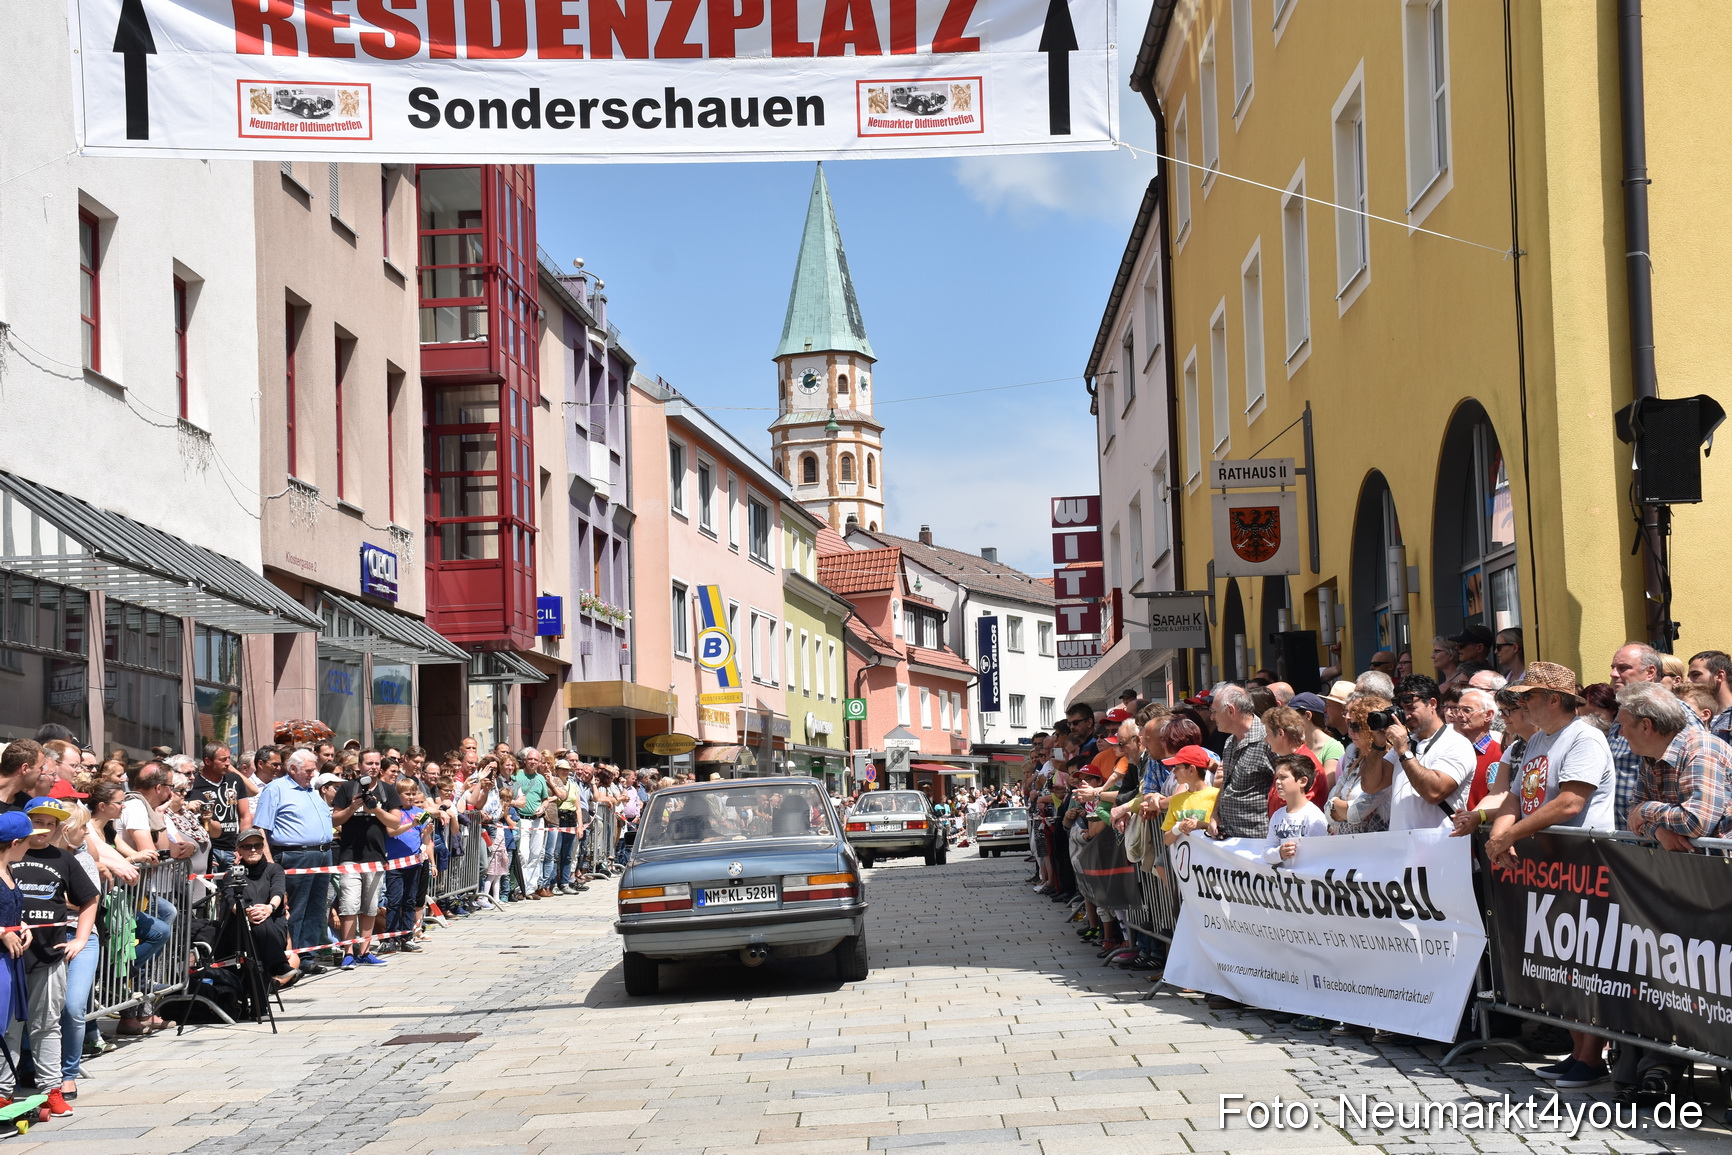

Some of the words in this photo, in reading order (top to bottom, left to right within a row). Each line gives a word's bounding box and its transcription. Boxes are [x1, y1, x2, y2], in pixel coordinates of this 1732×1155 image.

[234, 0, 981, 59] RESIDENZPLATZ
[407, 86, 826, 130] Sonderschauen
[249, 117, 299, 132] Neumarkter
[299, 120, 363, 133] Oldtimertreffen
[867, 116, 914, 129] Neumarkter
[914, 114, 975, 129] Oldtimertreffen
[1218, 466, 1277, 480] RATHAUS
[1279, 465, 1287, 478] II
[536, 608, 557, 620] CIL
[1152, 614, 1190, 627] SARAH
[1192, 612, 1202, 625] K
[1174, 625, 1203, 633] LIFESTYLE
[703, 637, 722, 658] B
[990, 624, 998, 670] TAILOR
[1059, 657, 1102, 669] WEIDE
[1490, 858, 1610, 898] FAHRSCHULE
[705, 890, 720, 903] NM
[728, 888, 744, 902] KL
[745, 885, 776, 900] 528H
[28, 910, 55, 920] CREW
[1204, 914, 1222, 930] DAS
[1224, 917, 1322, 946] NACHRICHTENPORTAL
[1323, 929, 1348, 949] FÜR
[1216, 961, 1300, 985] www.neumarktaktuell.de
[1322, 976, 1435, 1005] facebook.com/neumarktaktuell
[1522, 957, 1568, 985] Neumarkt
[1571, 968, 1631, 998] Burgthann
[1639, 981, 1693, 1013] Freystadt
